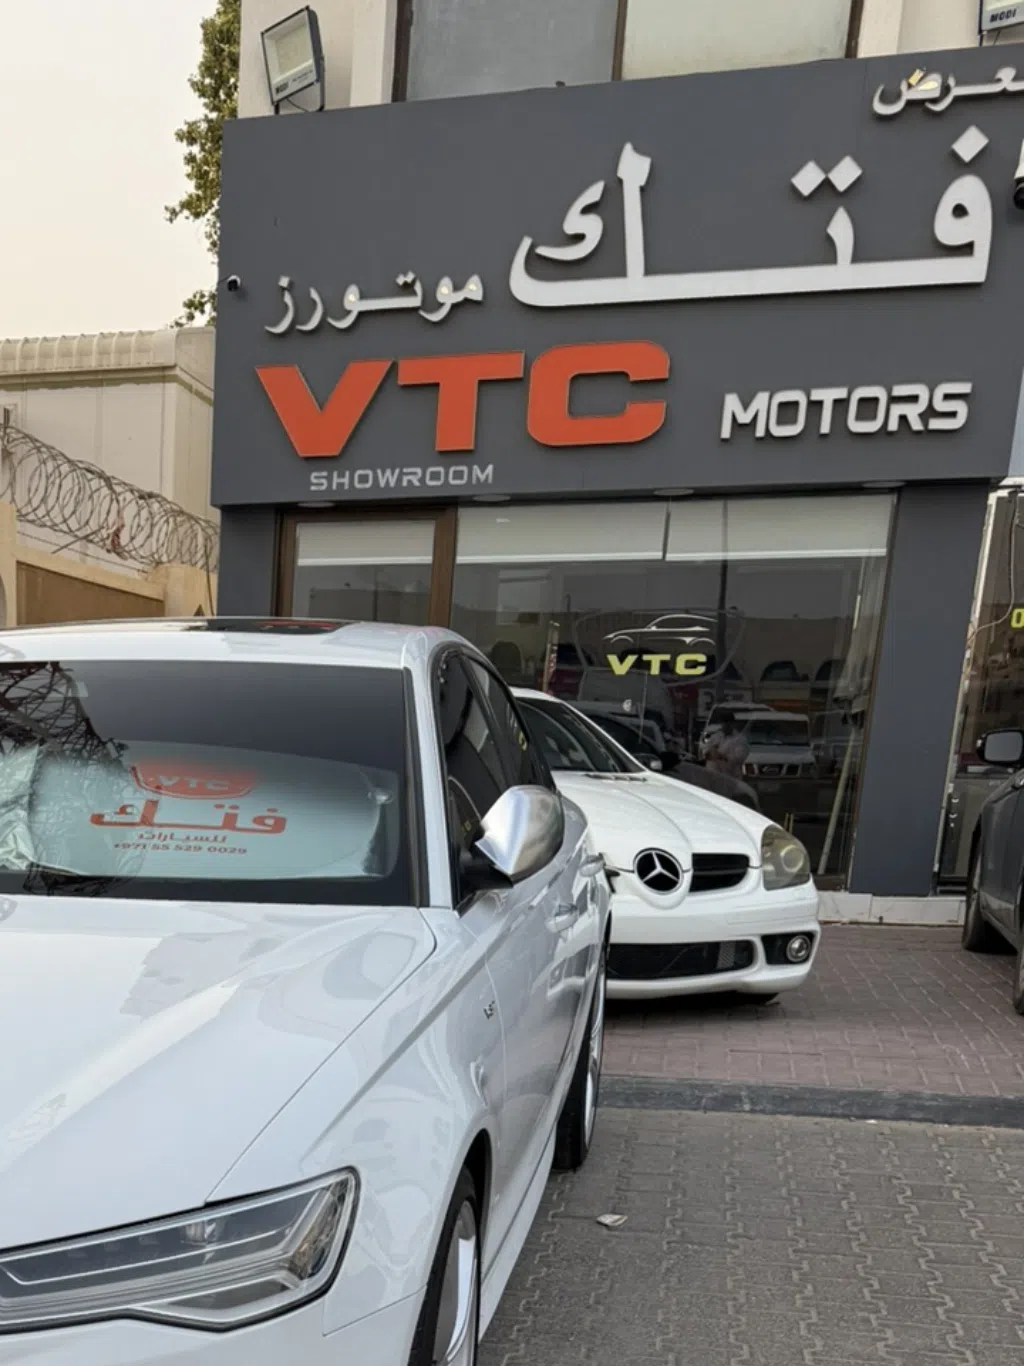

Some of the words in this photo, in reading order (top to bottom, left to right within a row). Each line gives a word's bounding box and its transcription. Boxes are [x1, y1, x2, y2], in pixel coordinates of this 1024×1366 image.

[873, 65, 1024, 116] عرض
[508, 124, 994, 308] فتك
[264, 270, 484, 335] موتورز
[255, 340, 671, 459] VTC
[720, 381, 973, 441] MOTORS
[308, 463, 495, 492] SHOWROOM
[607, 653, 707, 676] VTC
[158, 775, 231, 791] VTC
[90, 798, 287, 834] فتك
[207, 846, 247, 854] 0029
